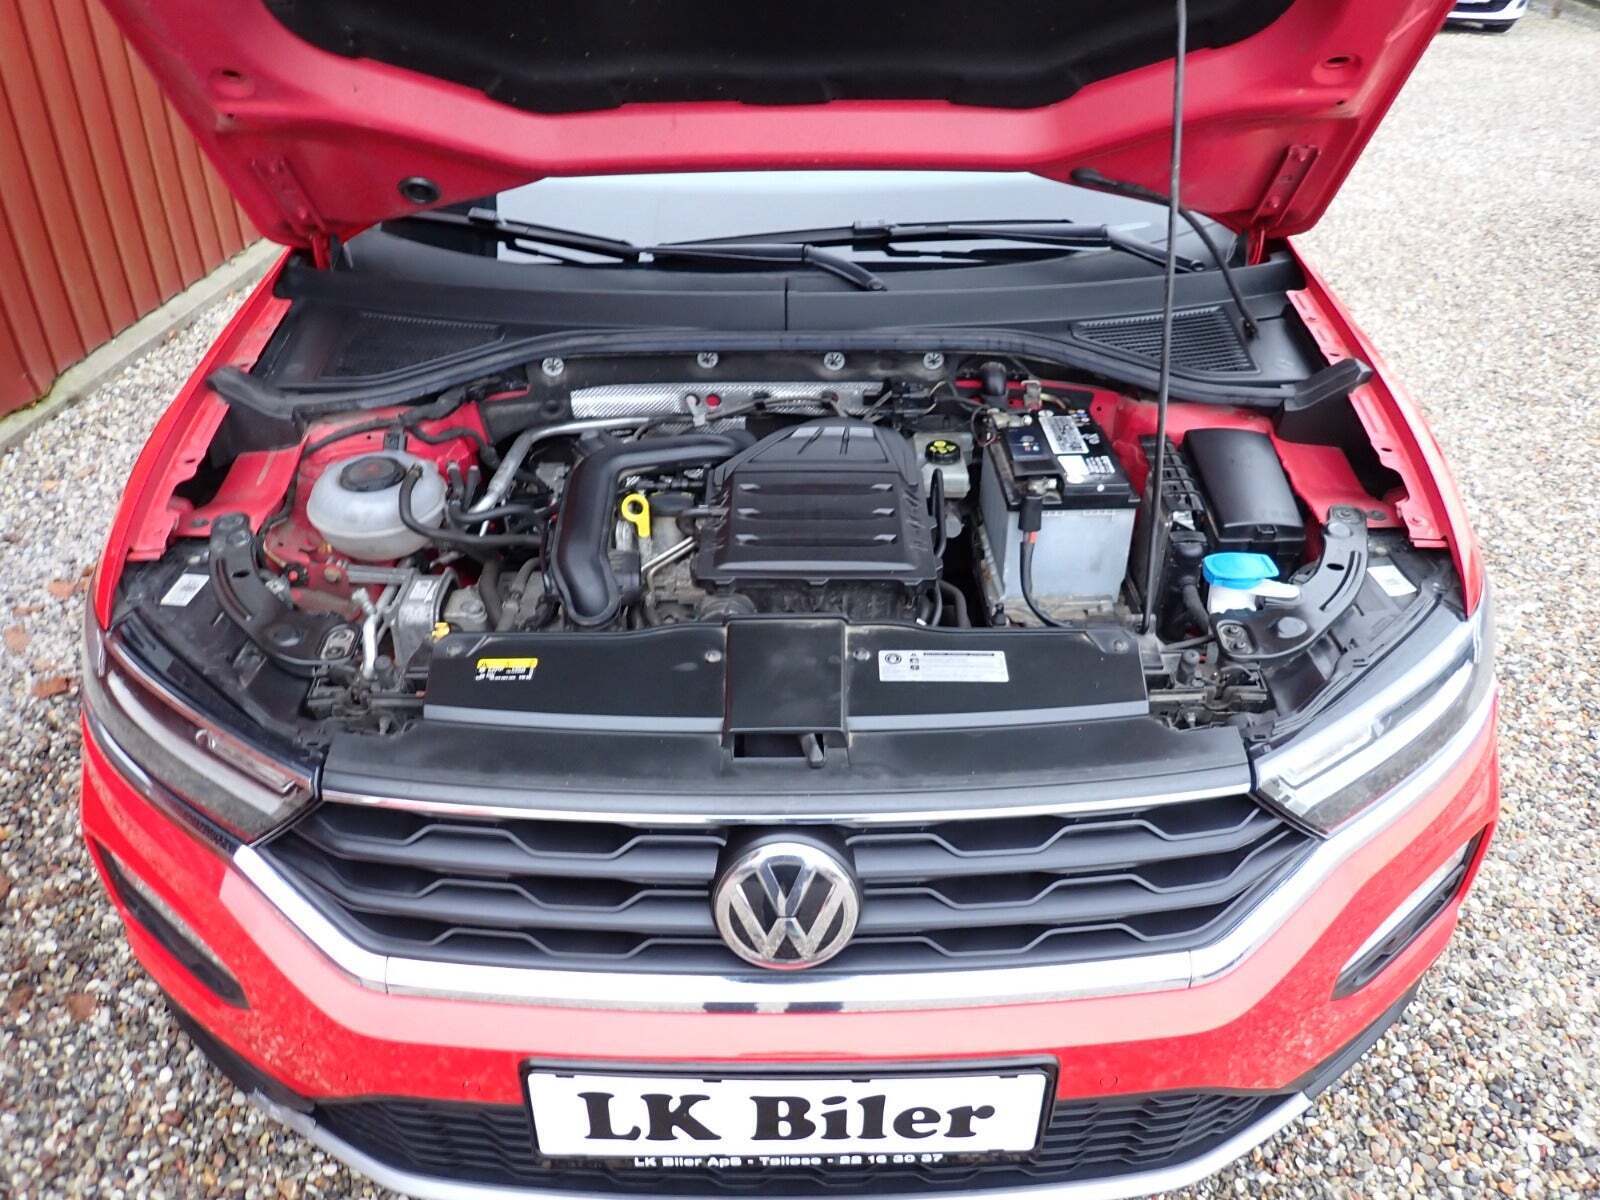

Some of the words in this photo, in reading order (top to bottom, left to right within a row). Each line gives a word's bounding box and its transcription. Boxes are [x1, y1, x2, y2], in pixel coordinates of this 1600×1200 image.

[577, 1091, 722, 1141] LK
[749, 1094, 996, 1141] Biler
[634, 1156, 657, 1167] LK
[662, 1156, 703, 1167] Biler
